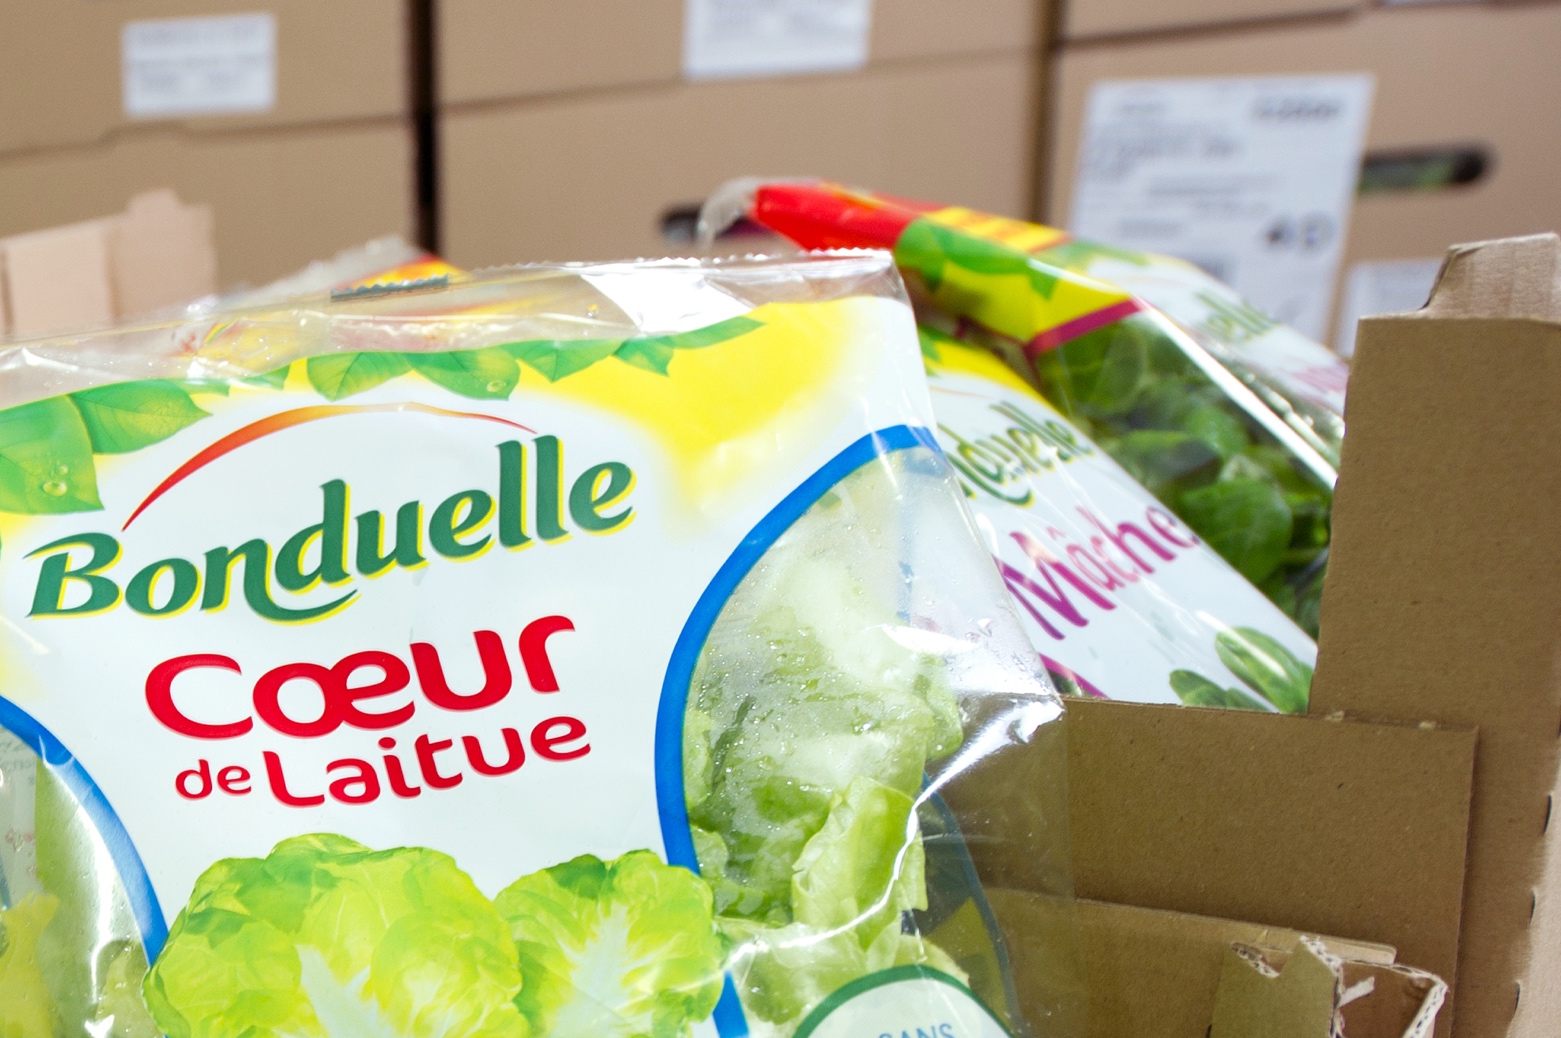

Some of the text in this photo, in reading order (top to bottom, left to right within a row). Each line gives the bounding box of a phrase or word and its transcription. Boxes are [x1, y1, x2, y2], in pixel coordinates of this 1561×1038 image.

[23, 434, 637, 626] Bonduelle
[992, 503, 1199, 640] Mâche
[144, 614, 576, 739] Cœur
[174, 715, 592, 809] de Laitue
